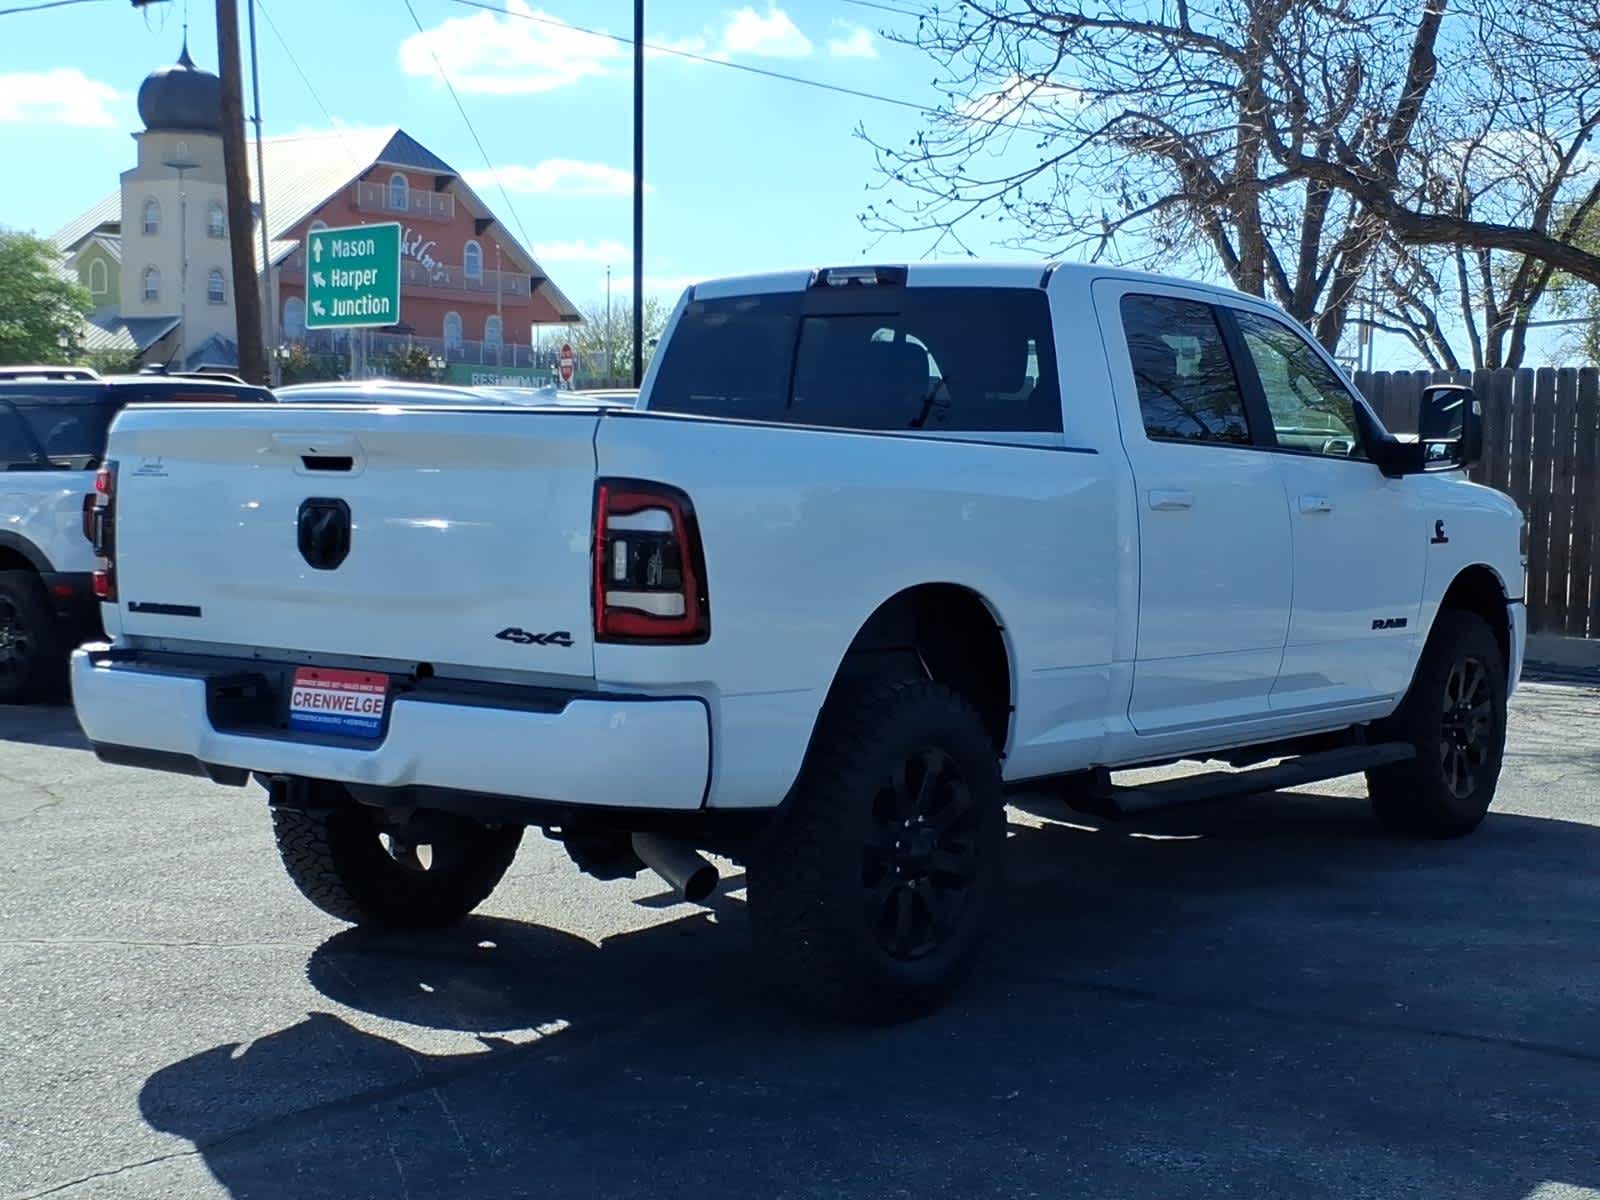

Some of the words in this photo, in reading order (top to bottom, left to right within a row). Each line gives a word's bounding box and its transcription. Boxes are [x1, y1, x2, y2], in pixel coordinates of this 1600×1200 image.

[331, 239, 375, 258] Mason
[331, 268, 378, 291] Harper
[331, 293, 390, 316] Junction
[1371, 618, 1408, 630] RAM
[293, 692, 384, 714] CRENWELGE
